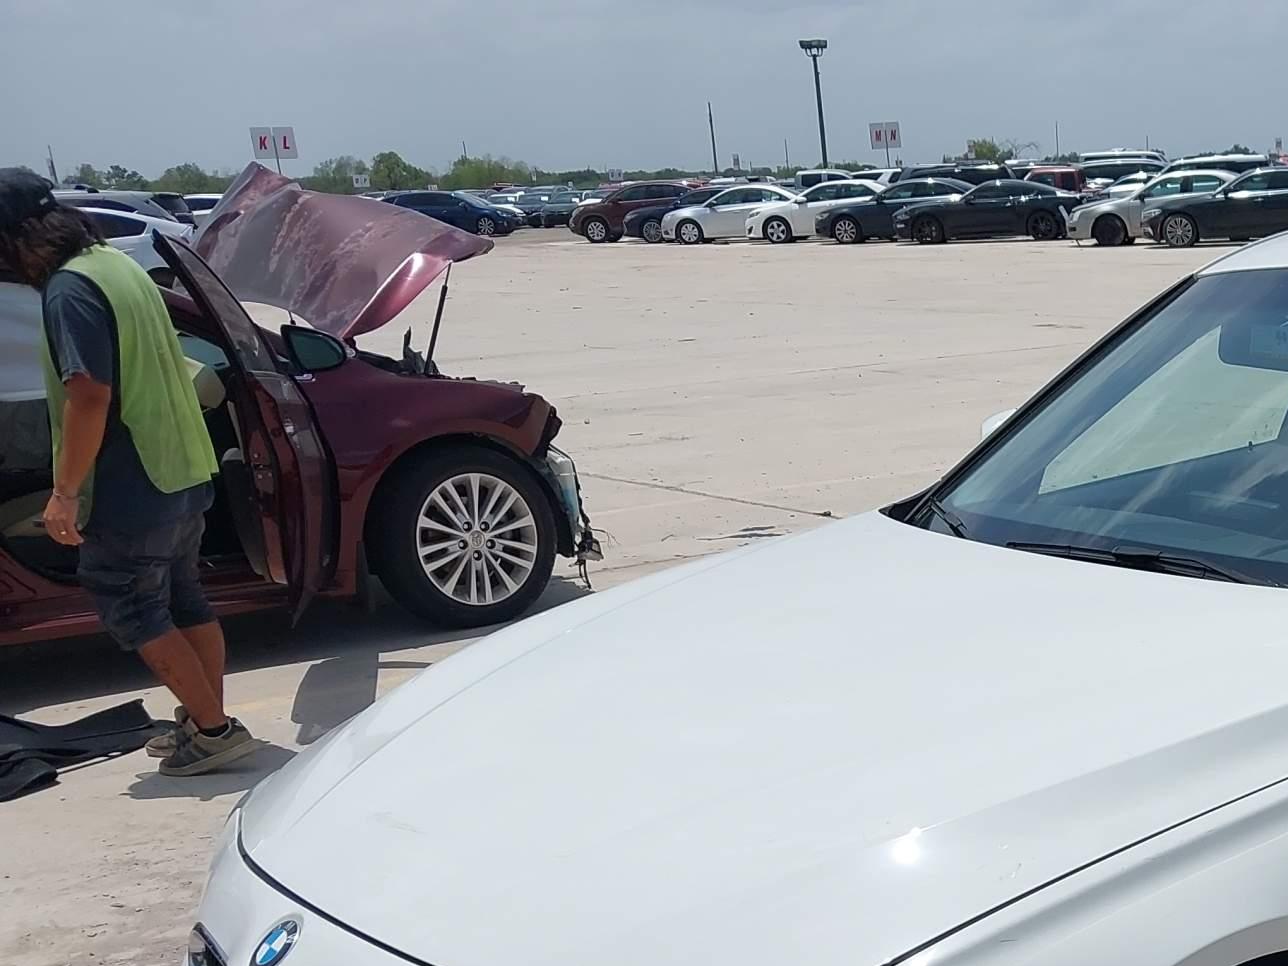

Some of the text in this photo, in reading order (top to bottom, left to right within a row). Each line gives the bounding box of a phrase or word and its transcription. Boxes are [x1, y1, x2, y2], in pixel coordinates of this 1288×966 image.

[875, 129, 896, 141] M N
[259, 135, 290, 150] K L
